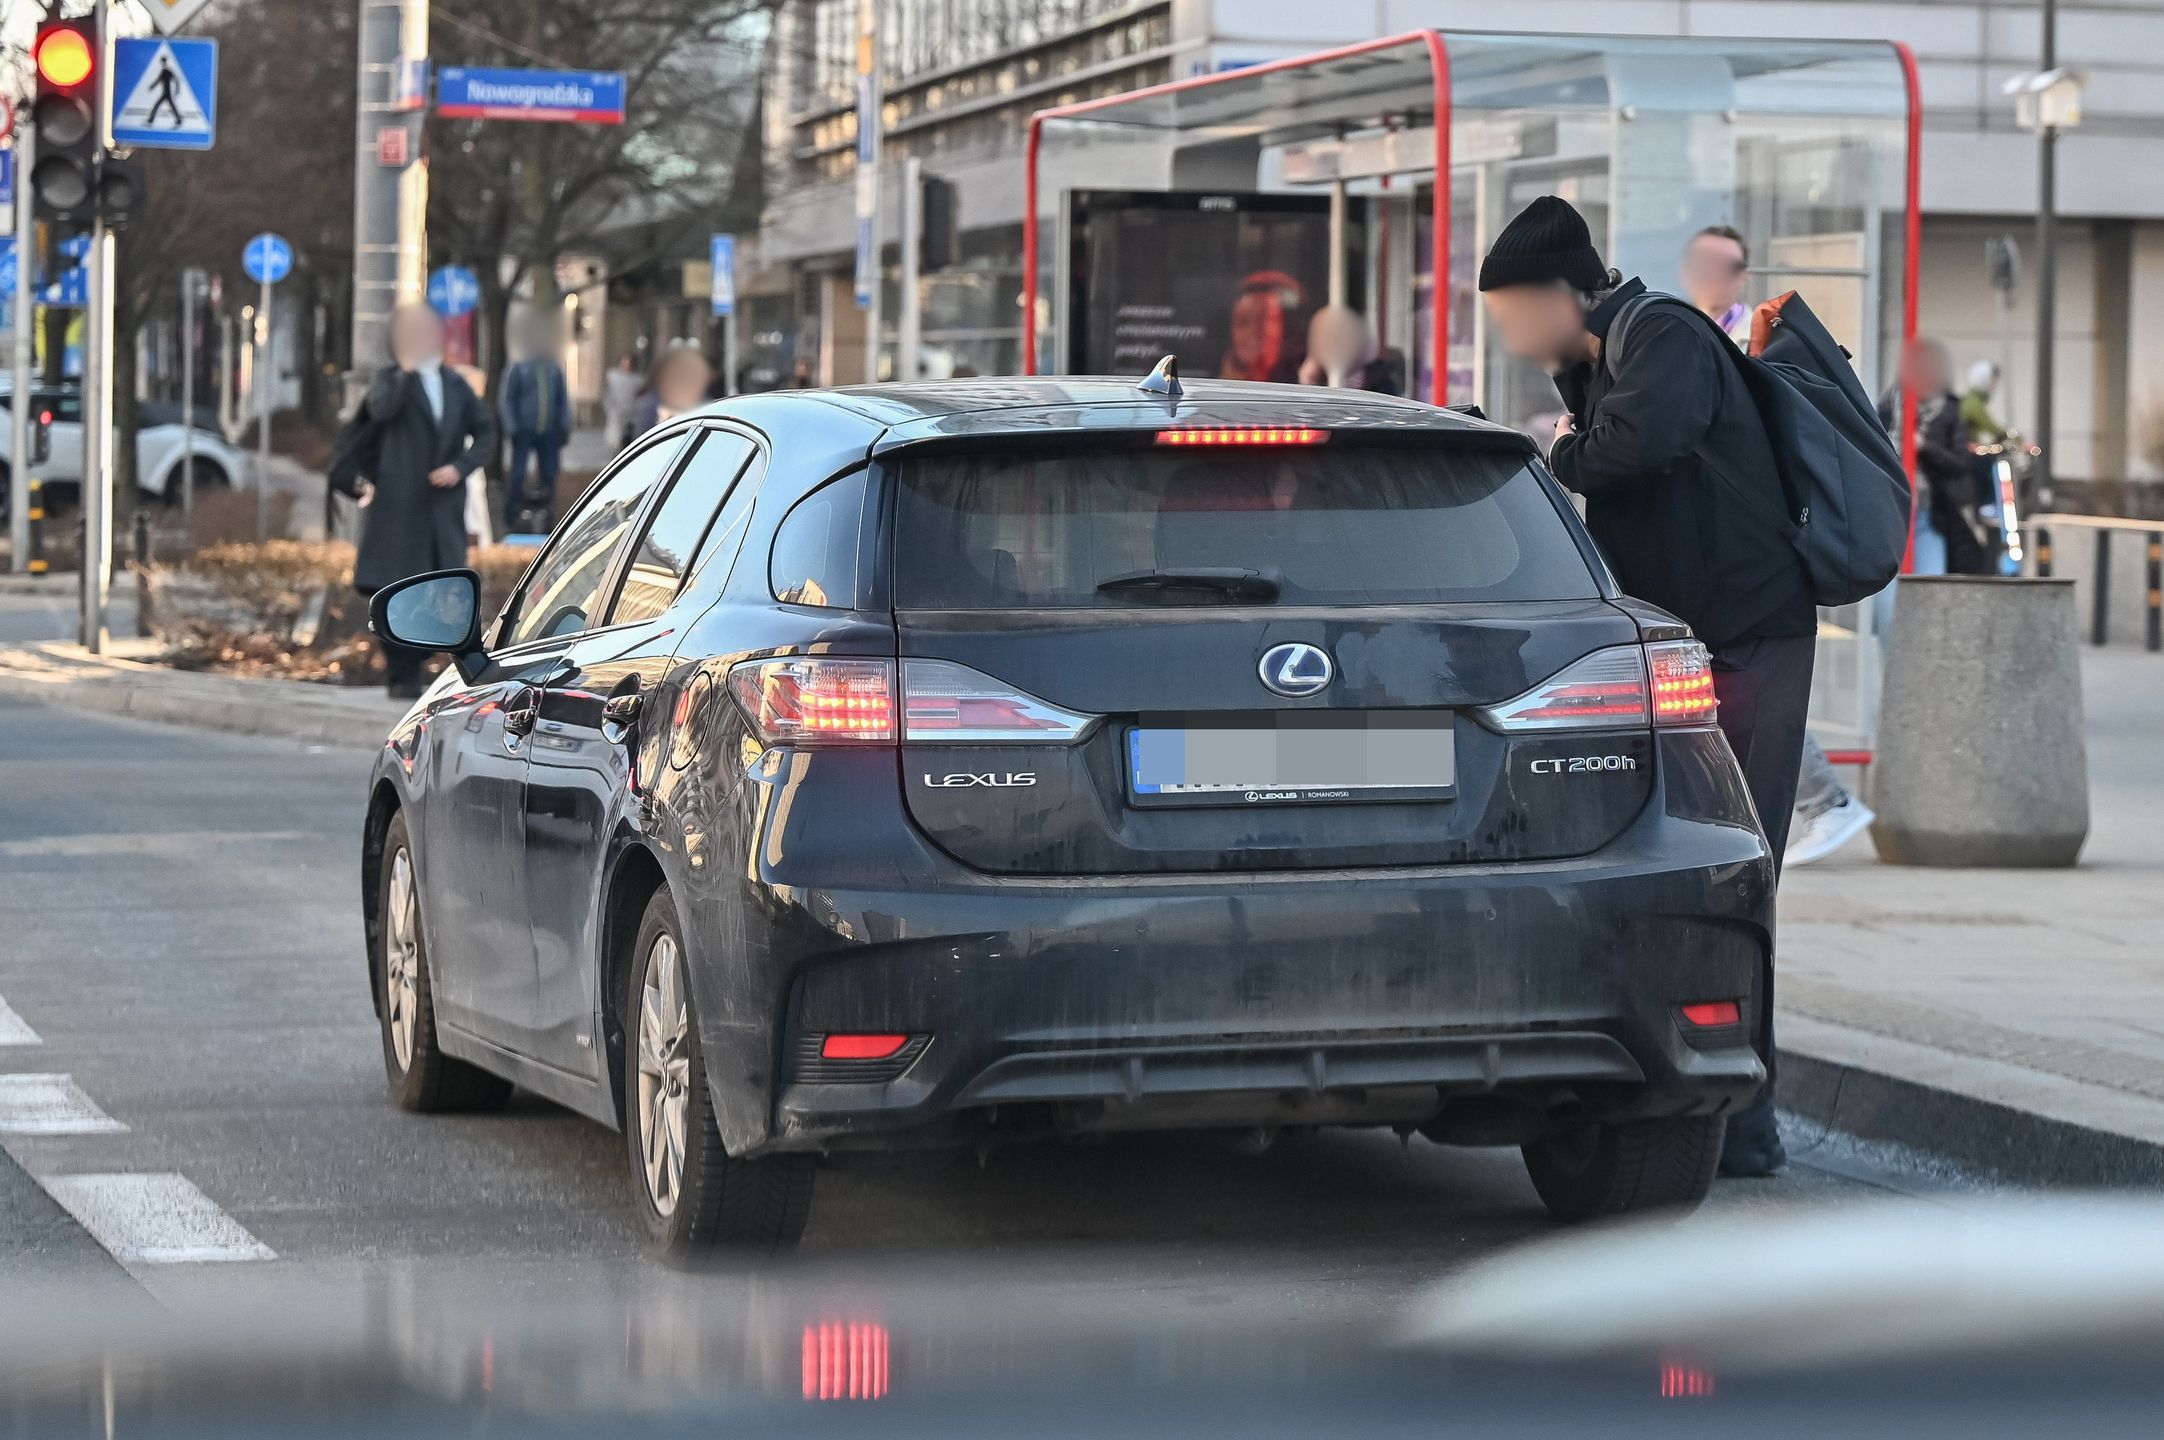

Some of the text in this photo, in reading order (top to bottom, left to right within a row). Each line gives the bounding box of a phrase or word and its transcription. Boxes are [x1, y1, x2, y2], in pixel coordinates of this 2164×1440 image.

[467, 79, 594, 108] Nowogrodzka
[924, 772, 1037, 788] LEXUS
[1259, 792, 1298, 800] LEXUS
[1308, 791, 1350, 799] ROMANOWSKI
